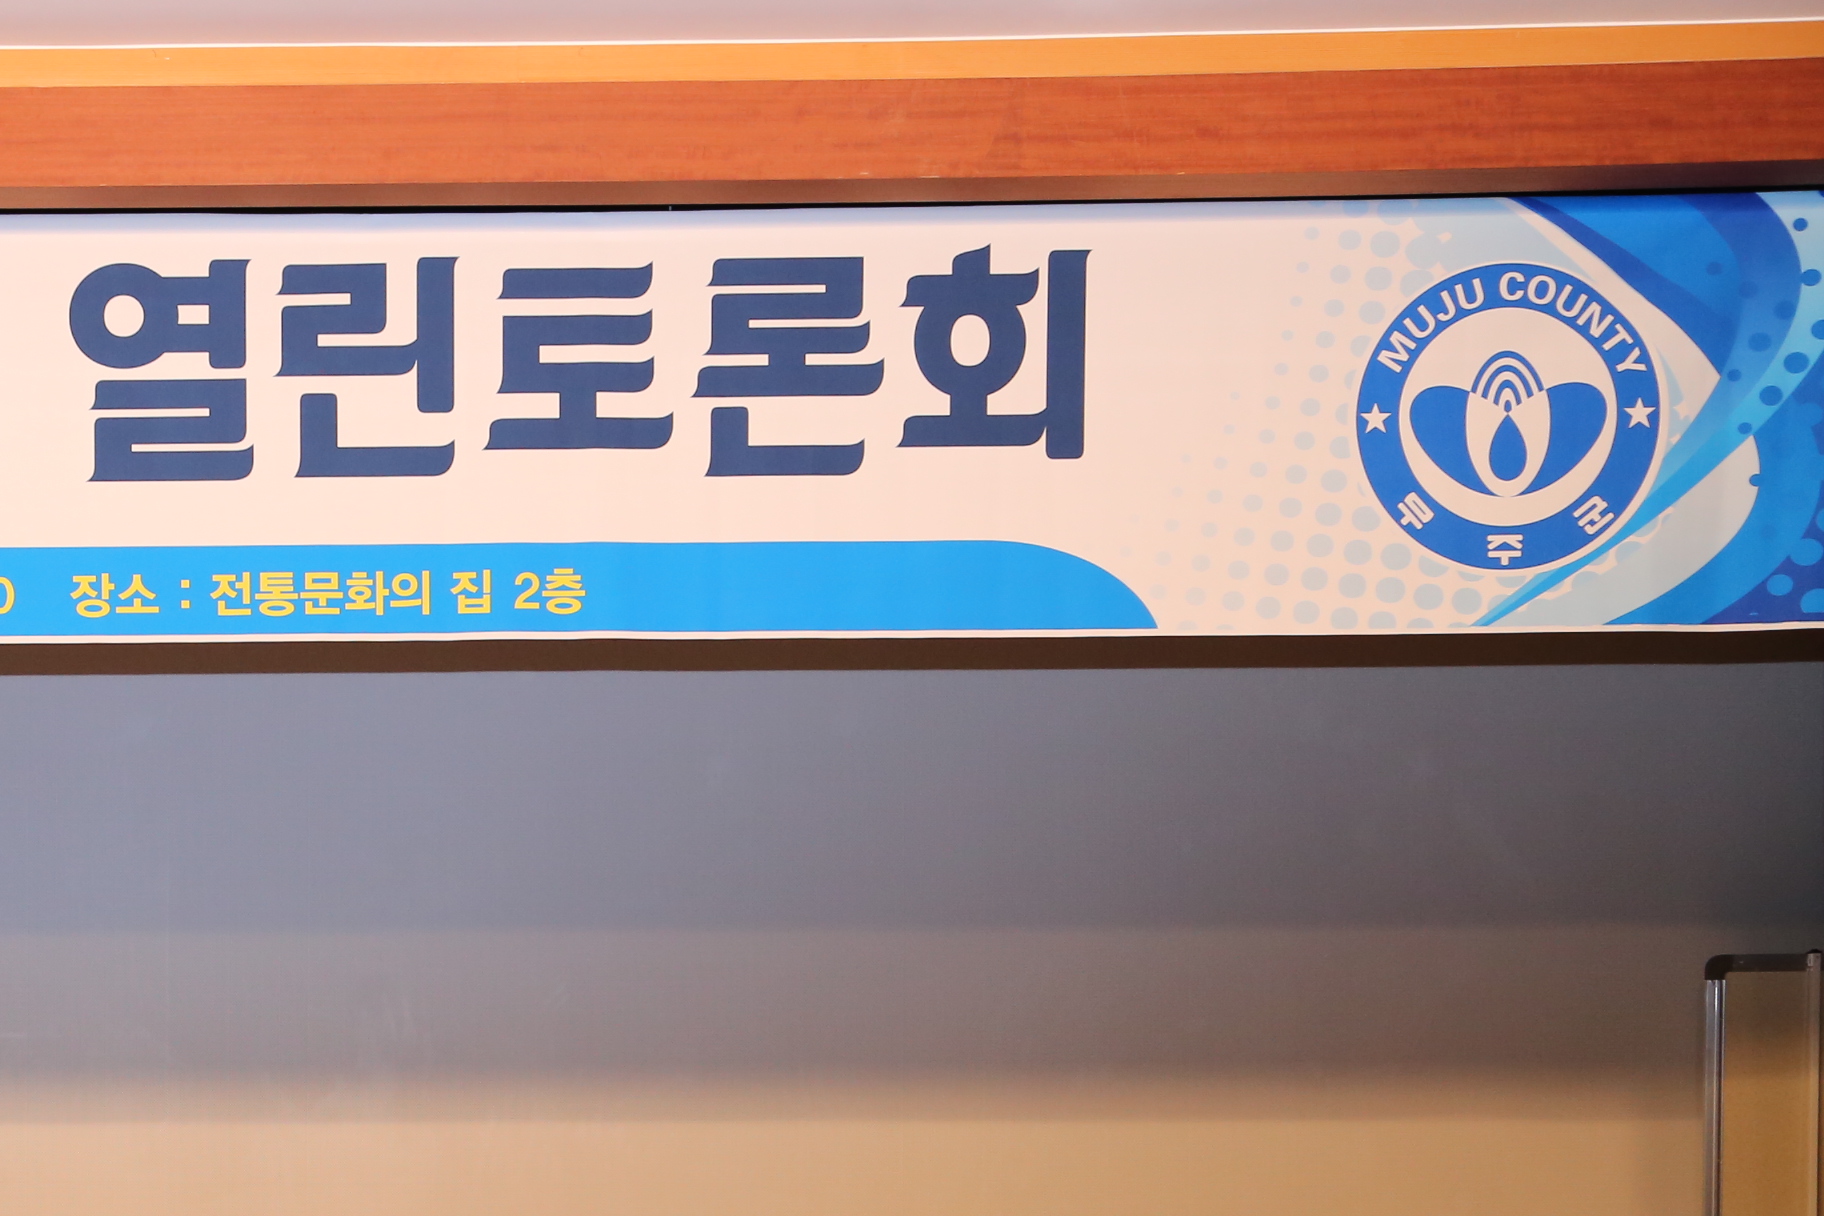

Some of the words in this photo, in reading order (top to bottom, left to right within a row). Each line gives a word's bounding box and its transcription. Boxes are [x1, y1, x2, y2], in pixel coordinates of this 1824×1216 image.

[69, 244, 1090, 481] 열린토론회
[1377, 278, 1484, 373] MUJU
[1499, 271, 1648, 373] COUNTY
[72, 574, 159, 617] 장소
[182, 580, 189, 608] :
[212, 571, 429, 616] 전통문화의
[452, 570, 490, 613] 집
[516, 569, 585, 614] 2층
